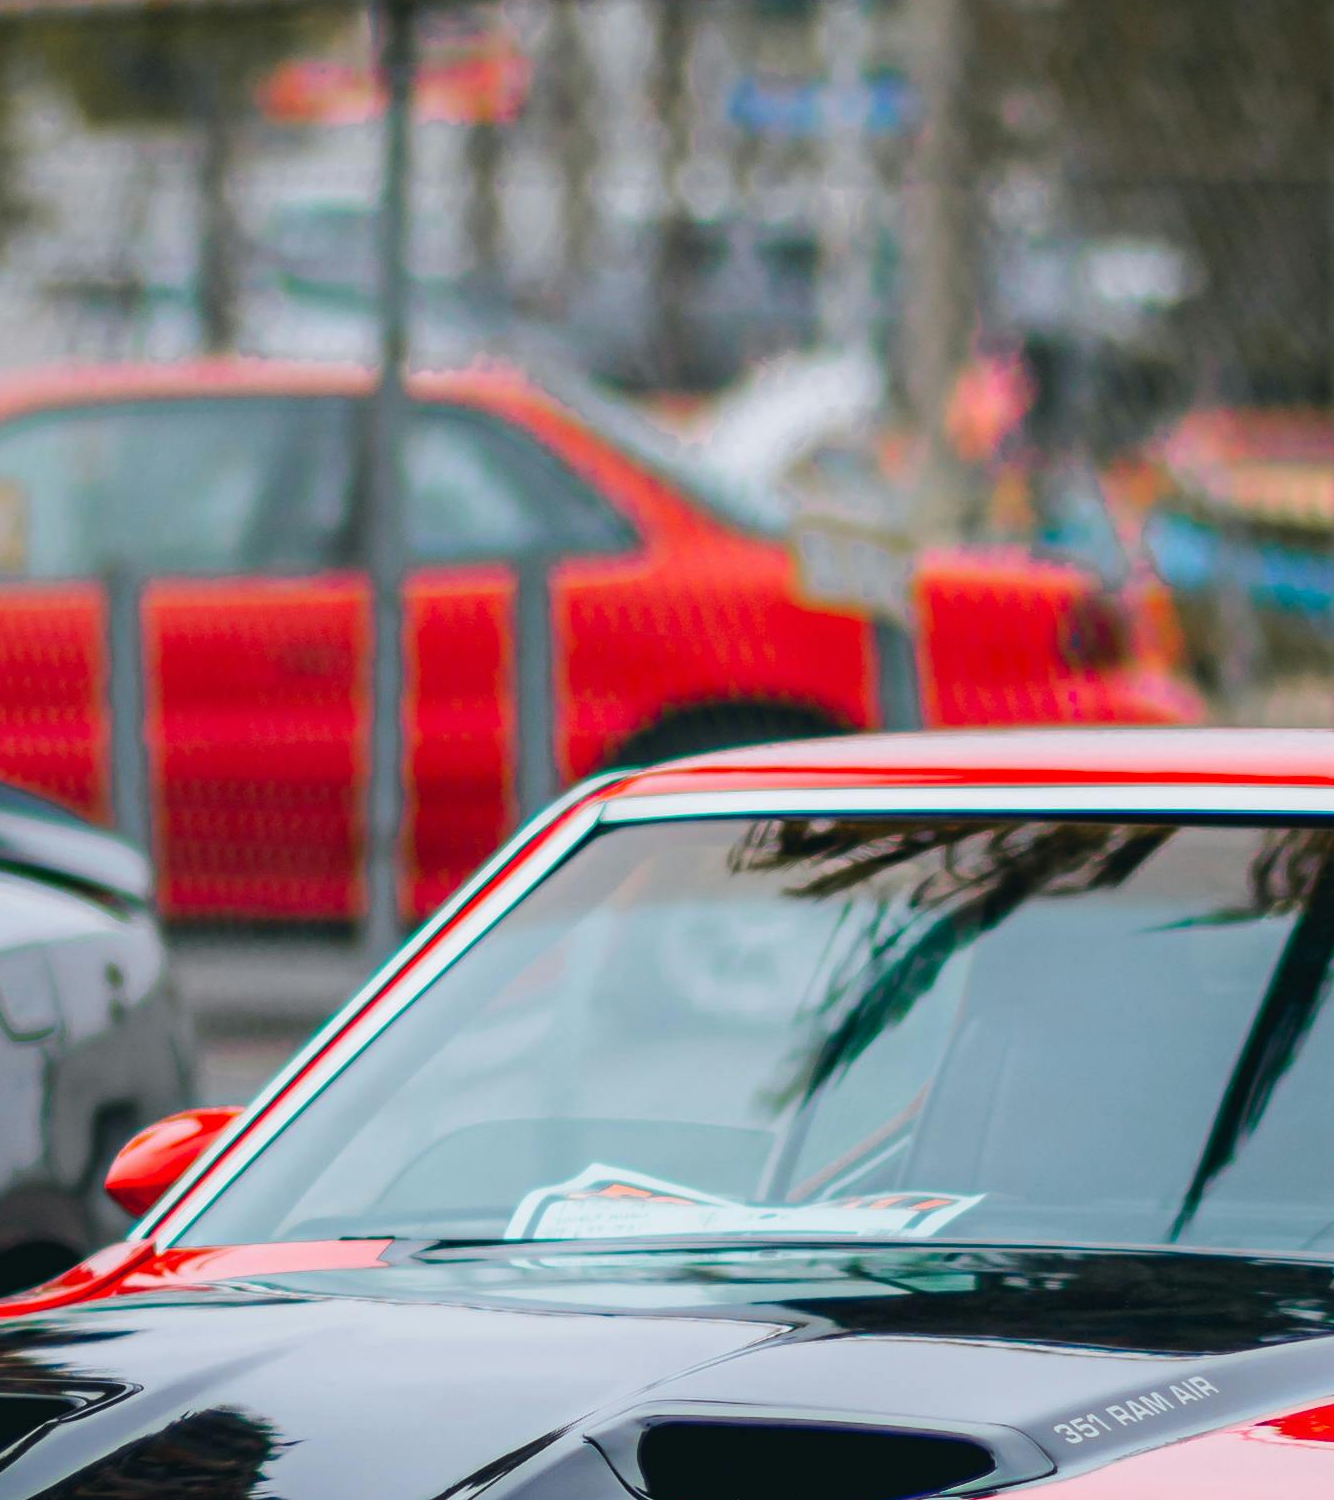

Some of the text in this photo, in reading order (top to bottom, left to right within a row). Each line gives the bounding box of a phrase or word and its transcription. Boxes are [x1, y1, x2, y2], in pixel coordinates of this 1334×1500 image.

[1053, 1376, 1220, 1445] 351 RAM AIR
